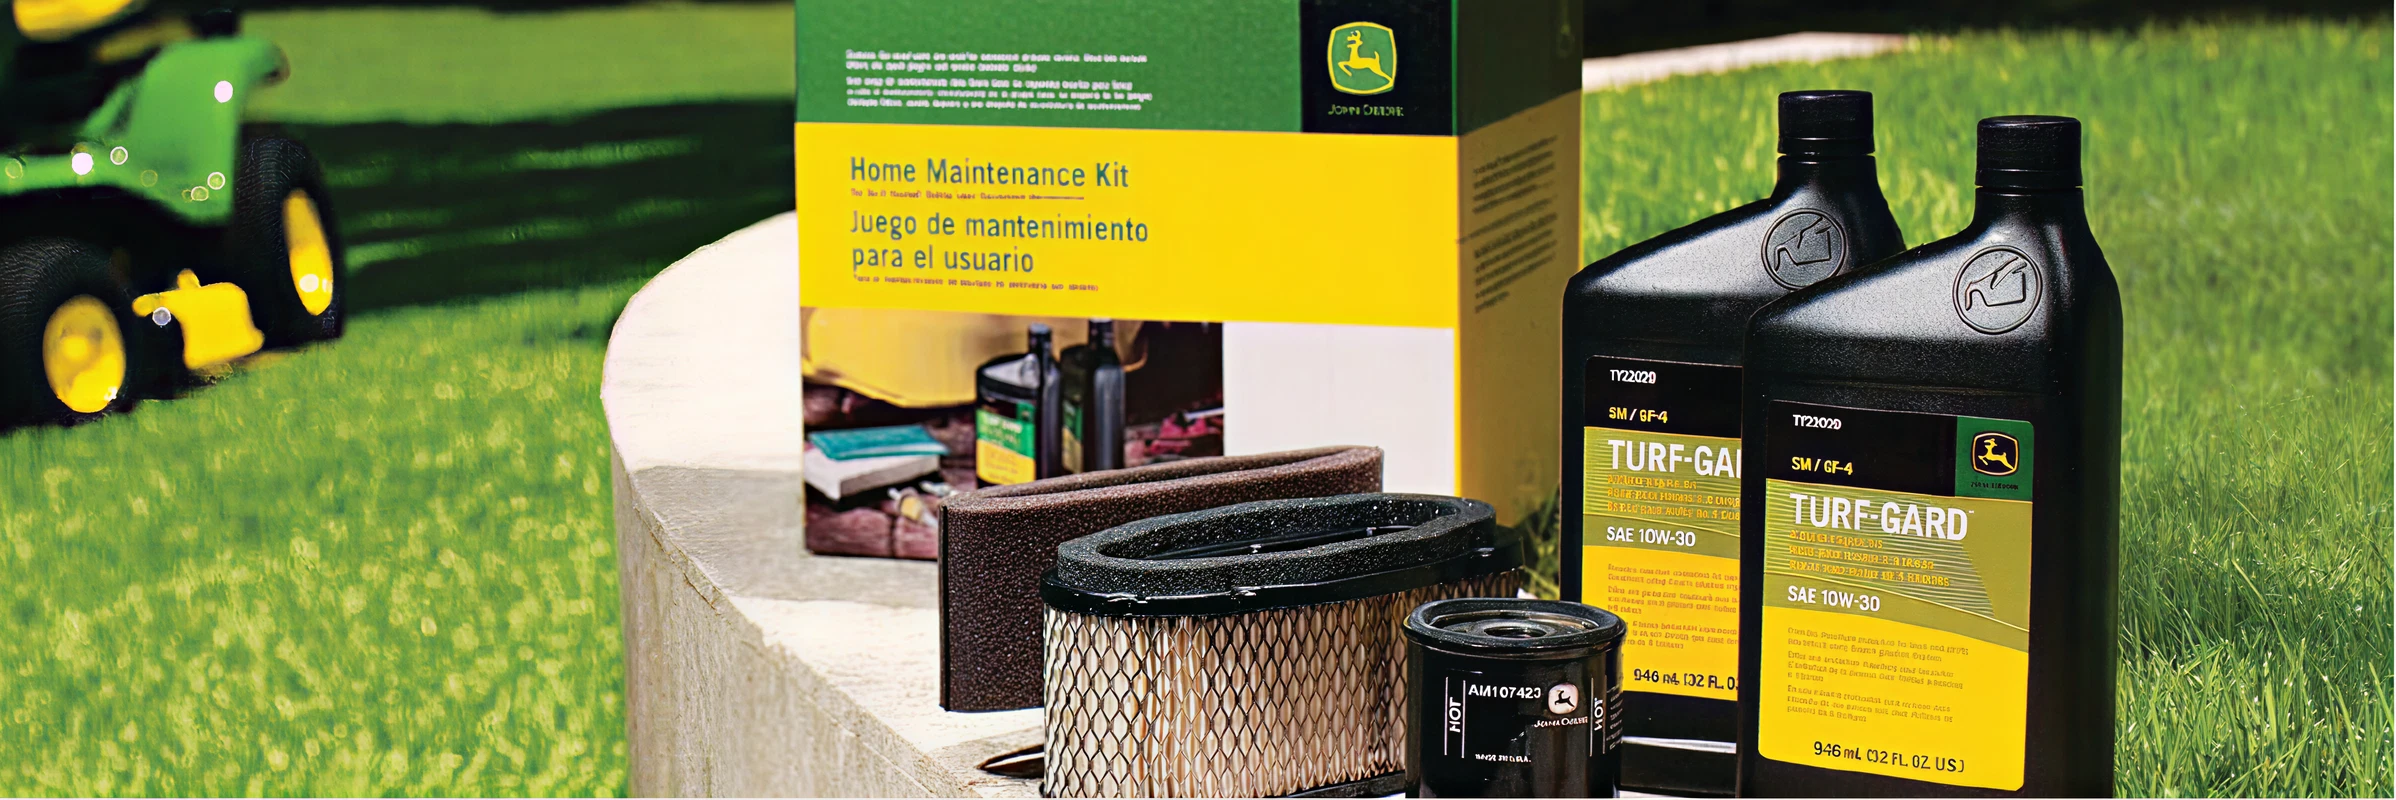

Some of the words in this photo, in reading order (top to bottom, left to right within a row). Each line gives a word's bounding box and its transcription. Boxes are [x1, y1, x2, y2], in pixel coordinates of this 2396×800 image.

[850, 157, 916, 183] Home
[927, 158, 1085, 187] Maintenance
[1096, 161, 1129, 188] Kit
[850, 210, 917, 241] Juego
[927, 212, 955, 236] de
[965, 213, 1149, 242] mantenimiento
[852, 247, 903, 272] para
[914, 244, 934, 269] el
[944, 246, 1034, 273] usuario
[1608, 407, 1627, 421] SM
[1791, 456, 1812, 471] SM
[1823, 460, 1854, 476] GF-4
[1606, 526, 1635, 543] SAE
[1638, 528, 1696, 547] 10W-30
[1787, 585, 1816, 604] SAE
[1822, 589, 1881, 612] 10W-30
[1448, 697, 1462, 733] HOT
[1593, 698, 1604, 731] HOT
[1813, 741, 1842, 757] 946
[1843, 747, 1862, 760] mL
